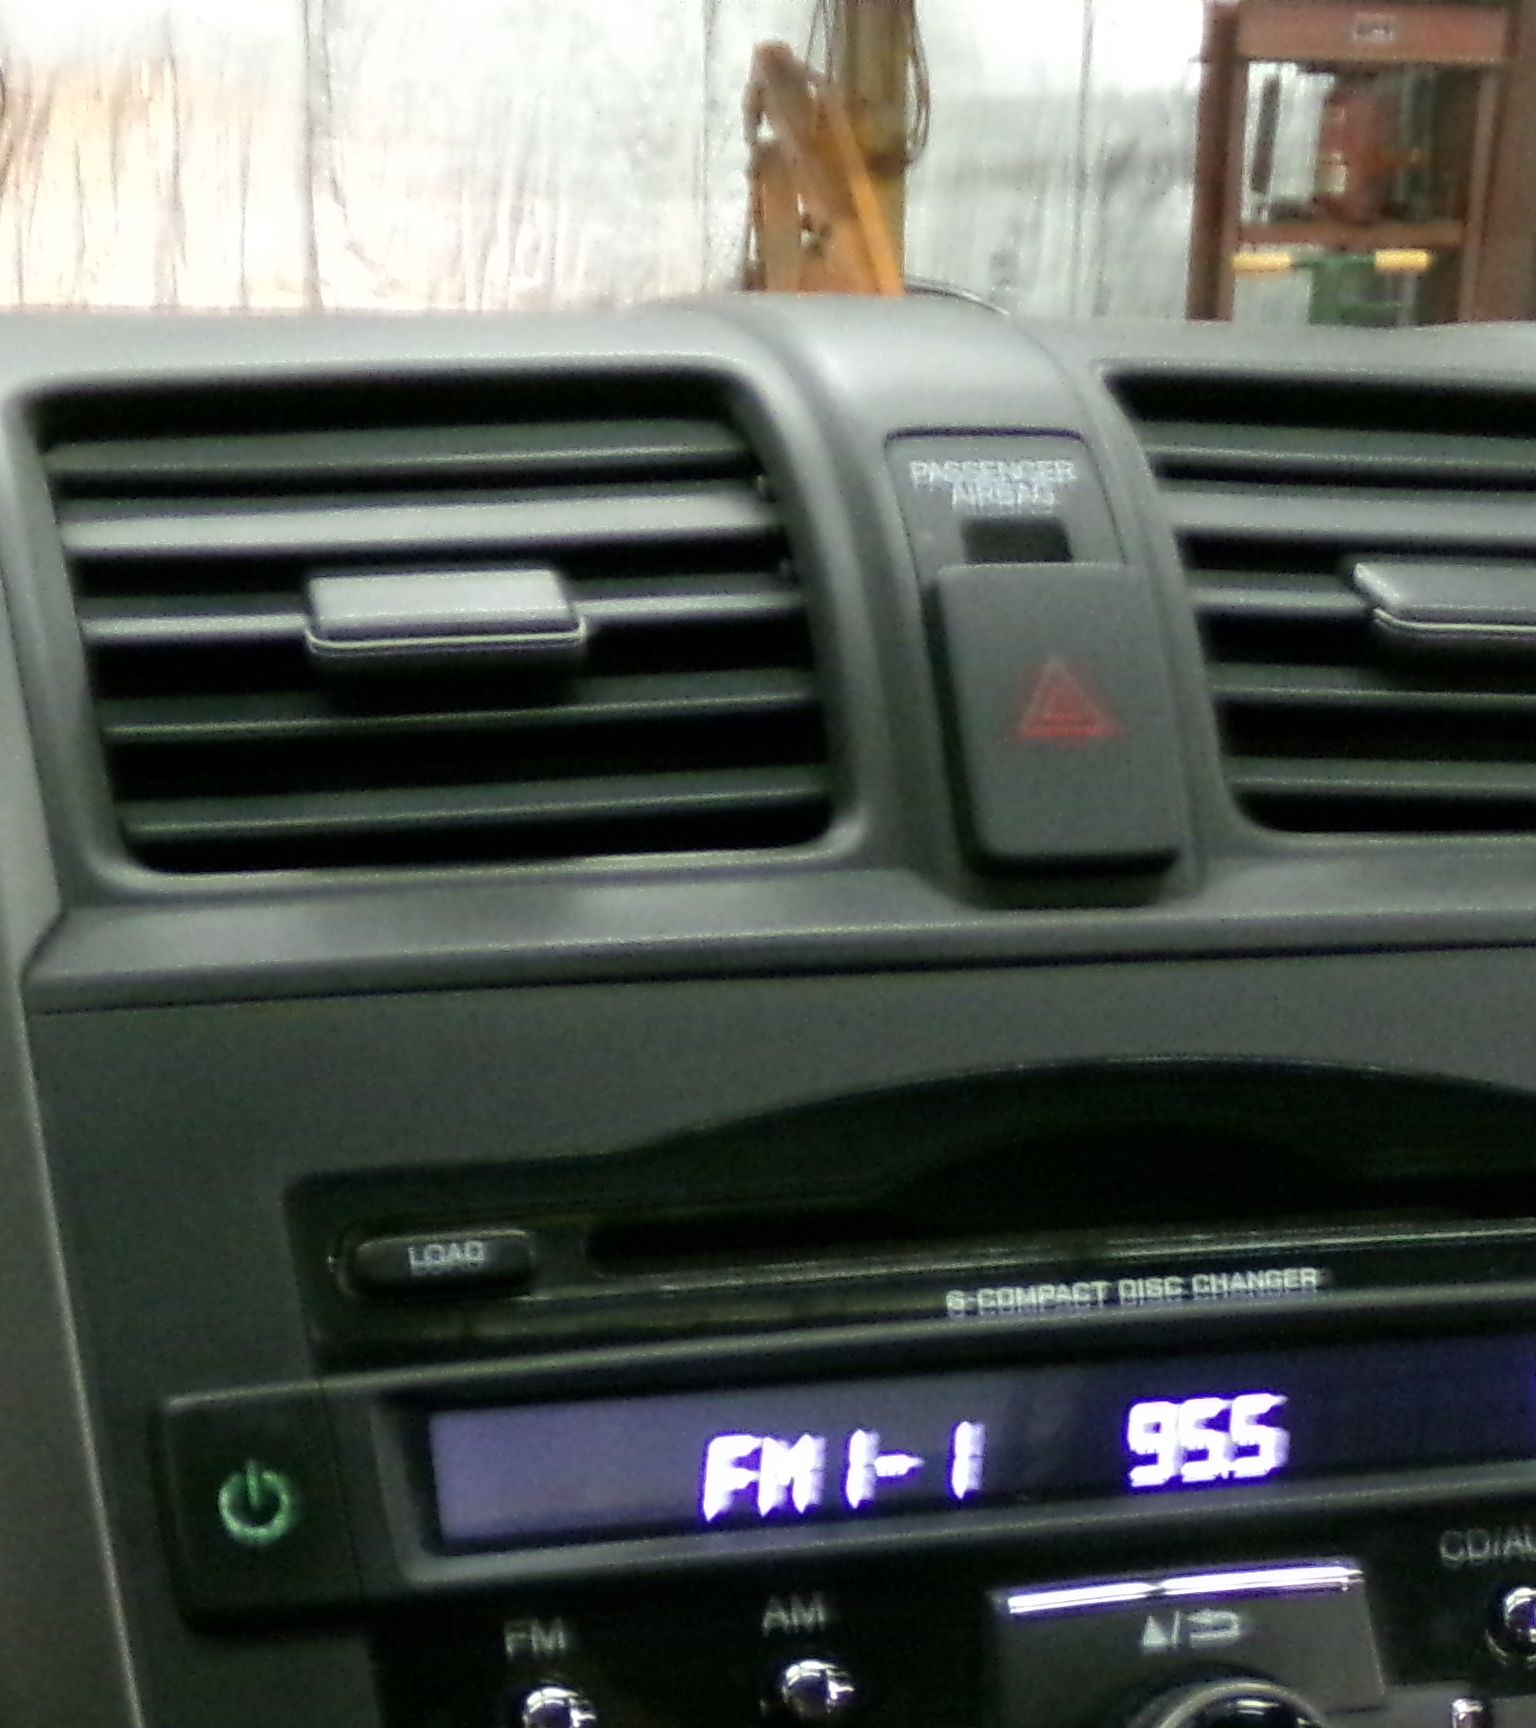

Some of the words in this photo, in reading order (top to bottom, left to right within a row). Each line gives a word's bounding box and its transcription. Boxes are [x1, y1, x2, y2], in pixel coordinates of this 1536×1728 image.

[408, 1240, 485, 1275] LOAD
[1118, 1275, 1184, 1305] DISC
[1192, 1267, 1321, 1295] CHANGER
[763, 1598, 830, 1635] AM
[503, 1618, 568, 1660] FM
